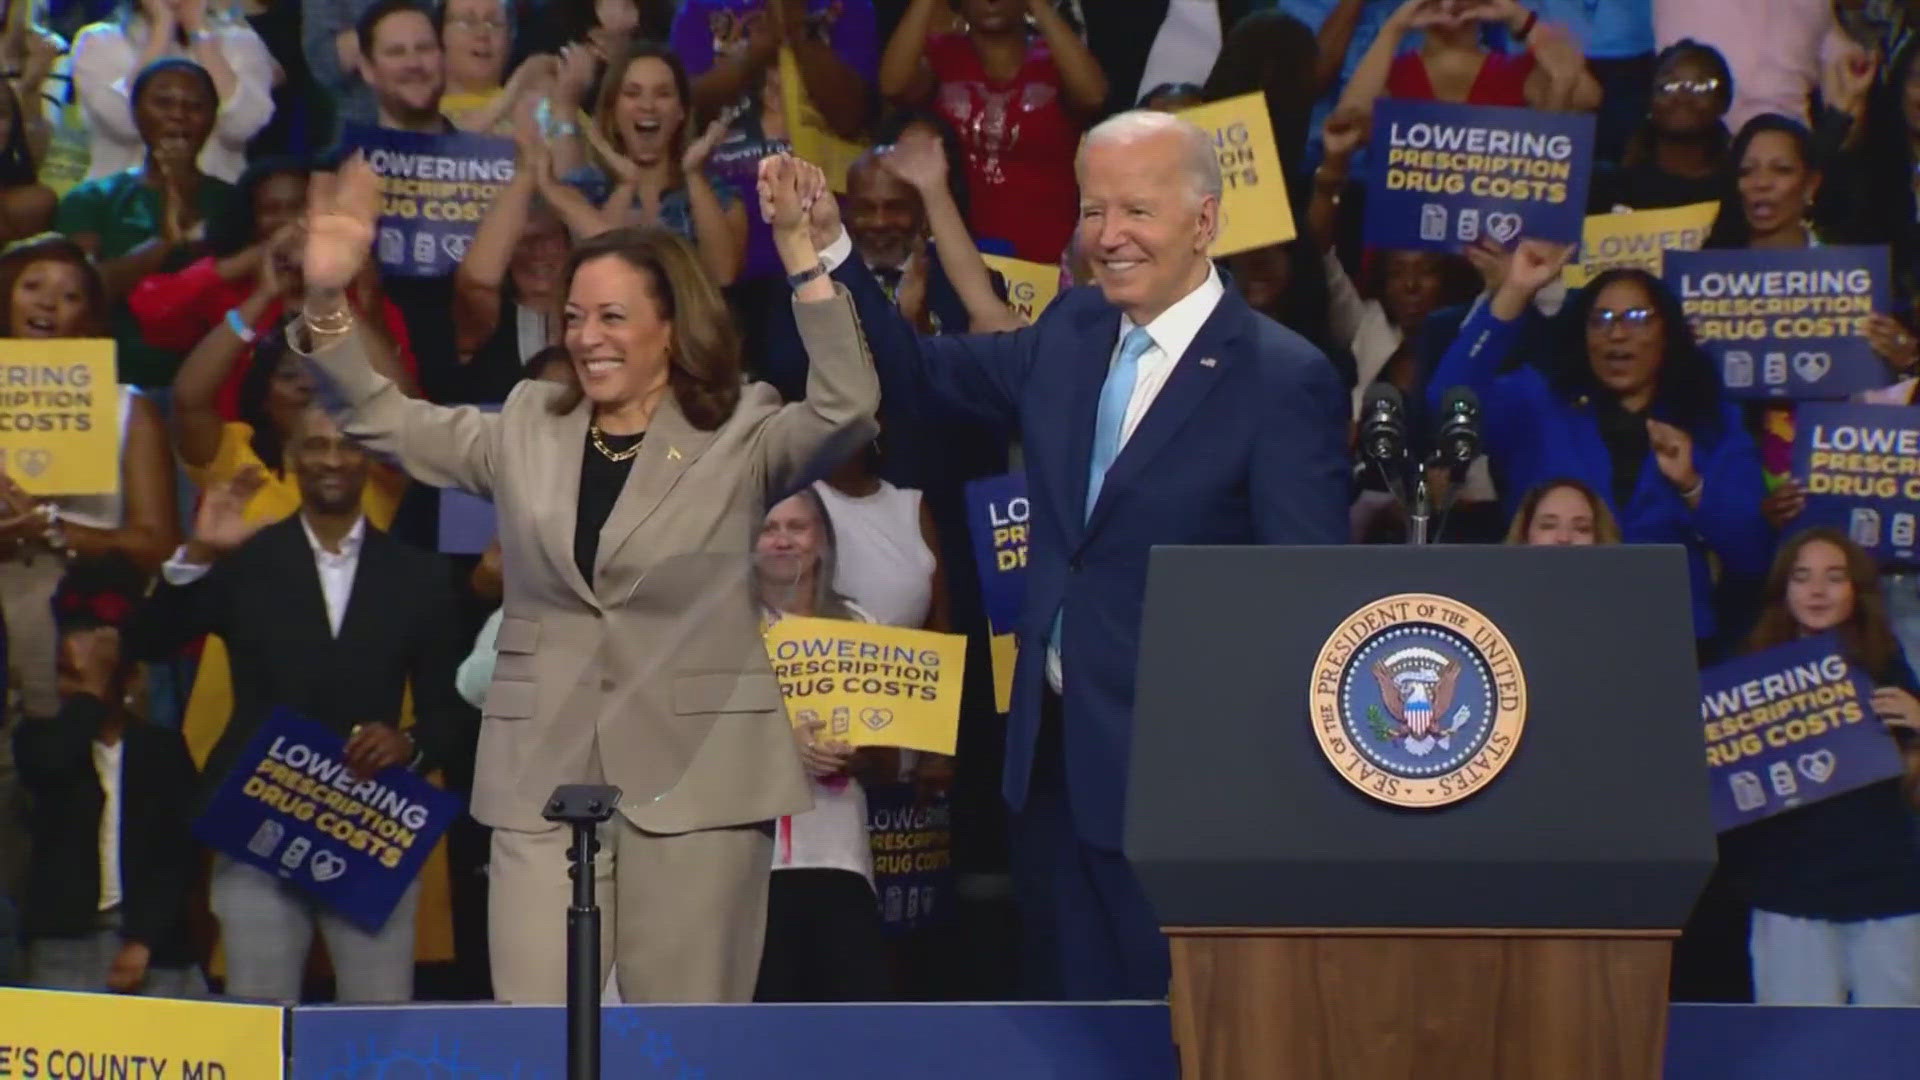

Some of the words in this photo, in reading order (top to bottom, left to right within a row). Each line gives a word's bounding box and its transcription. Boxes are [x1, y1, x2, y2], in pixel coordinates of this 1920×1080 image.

[1390, 122, 1573, 160] LOWERING
[1388, 148, 1571, 180] PRESCRIPTION
[1385, 169, 1465, 195] DRUG
[1470, 175, 1567, 204] COSTS
[1681, 269, 1872, 298] LOWERING
[1682, 296, 1873, 316] PRESCRIPTION
[1697, 318, 1768, 341] RUG
[0, 364, 91, 387] RING
[0, 391, 92, 408] IPTION
[0, 413, 92, 432] COSTS
[1812, 424, 1920, 455] LOWE
[1808, 473, 1898, 498] DRUG
[1416, 604, 1437, 618] OF
[1441, 608, 1470, 628] THE
[770, 637, 940, 667] OWERING
[1317, 602, 1410, 696] PRESIDENT
[1473, 626, 1519, 712] UNITED
[843, 679, 937, 701] COSTS
[1320, 703, 1336, 733] THE
[1766, 701, 1864, 748] COSTS
[1330, 736, 1347, 754] OF
[1345, 756, 1400, 797] SEAL
[1438, 731, 1511, 797] STATES
[268, 735, 429, 830] LOWERING
[255, 758, 417, 849] PRESCRIPTION
[243, 775, 316, 821] DRUG
[316, 812, 403, 868] COSTS
[47, 1049, 167, 1080] COUNTY
